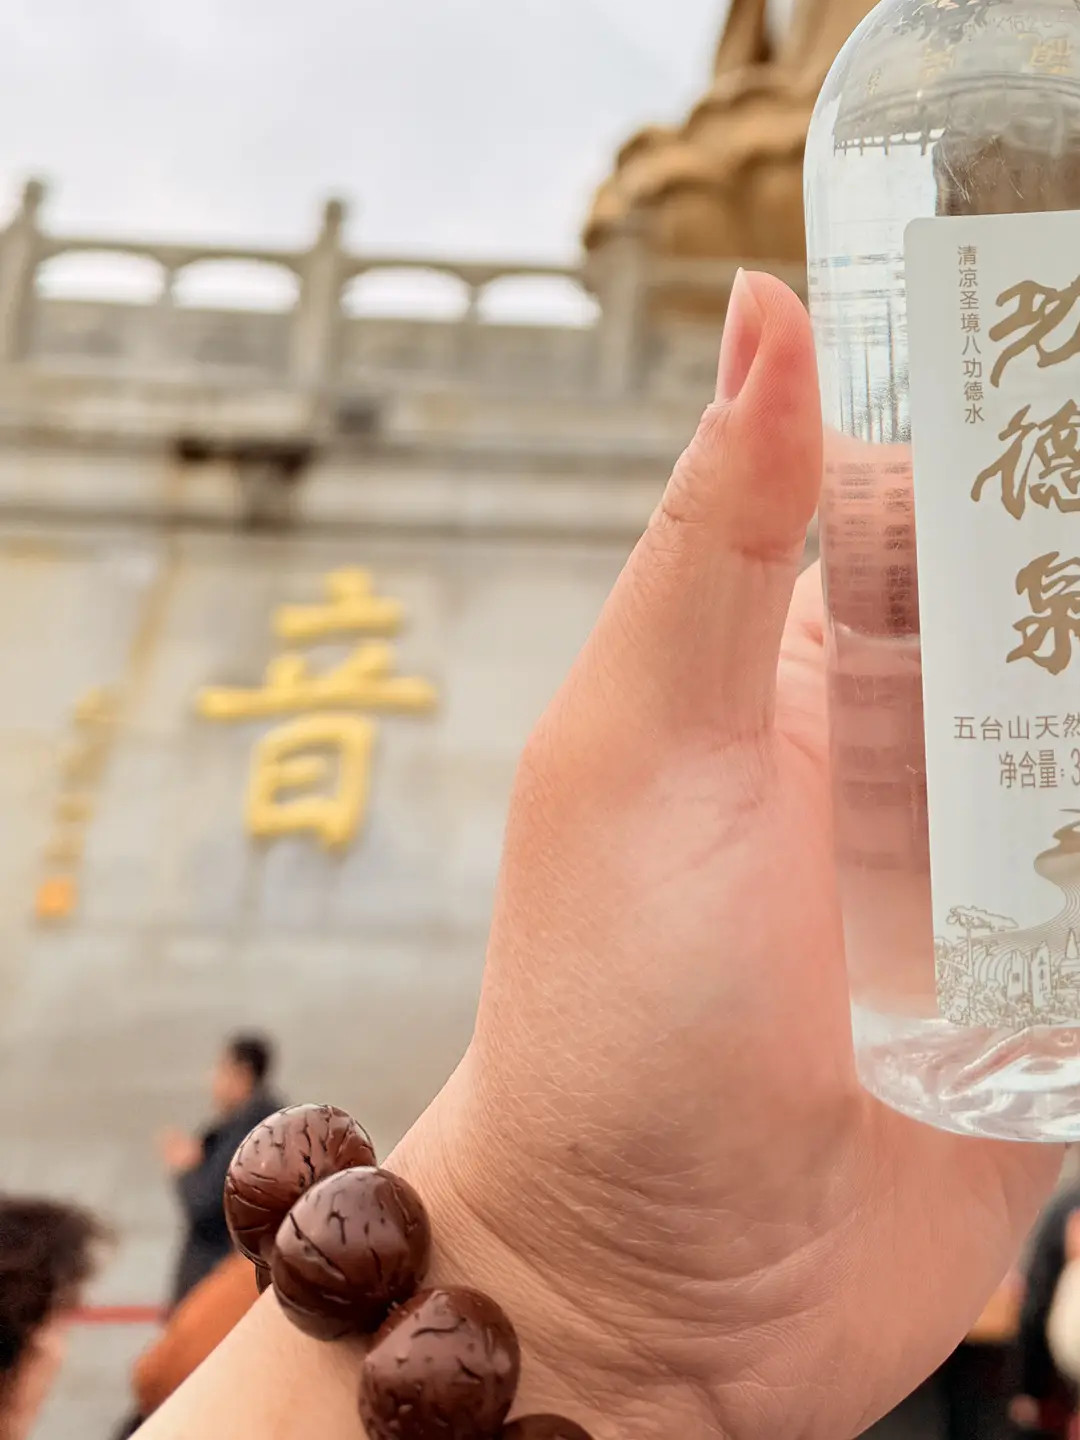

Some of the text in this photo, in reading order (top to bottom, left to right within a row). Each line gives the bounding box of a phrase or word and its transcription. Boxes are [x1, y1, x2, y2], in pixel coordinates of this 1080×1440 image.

[957, 245, 985, 425] 清凉圣境八功德水
[198, 566, 440, 854] 音
